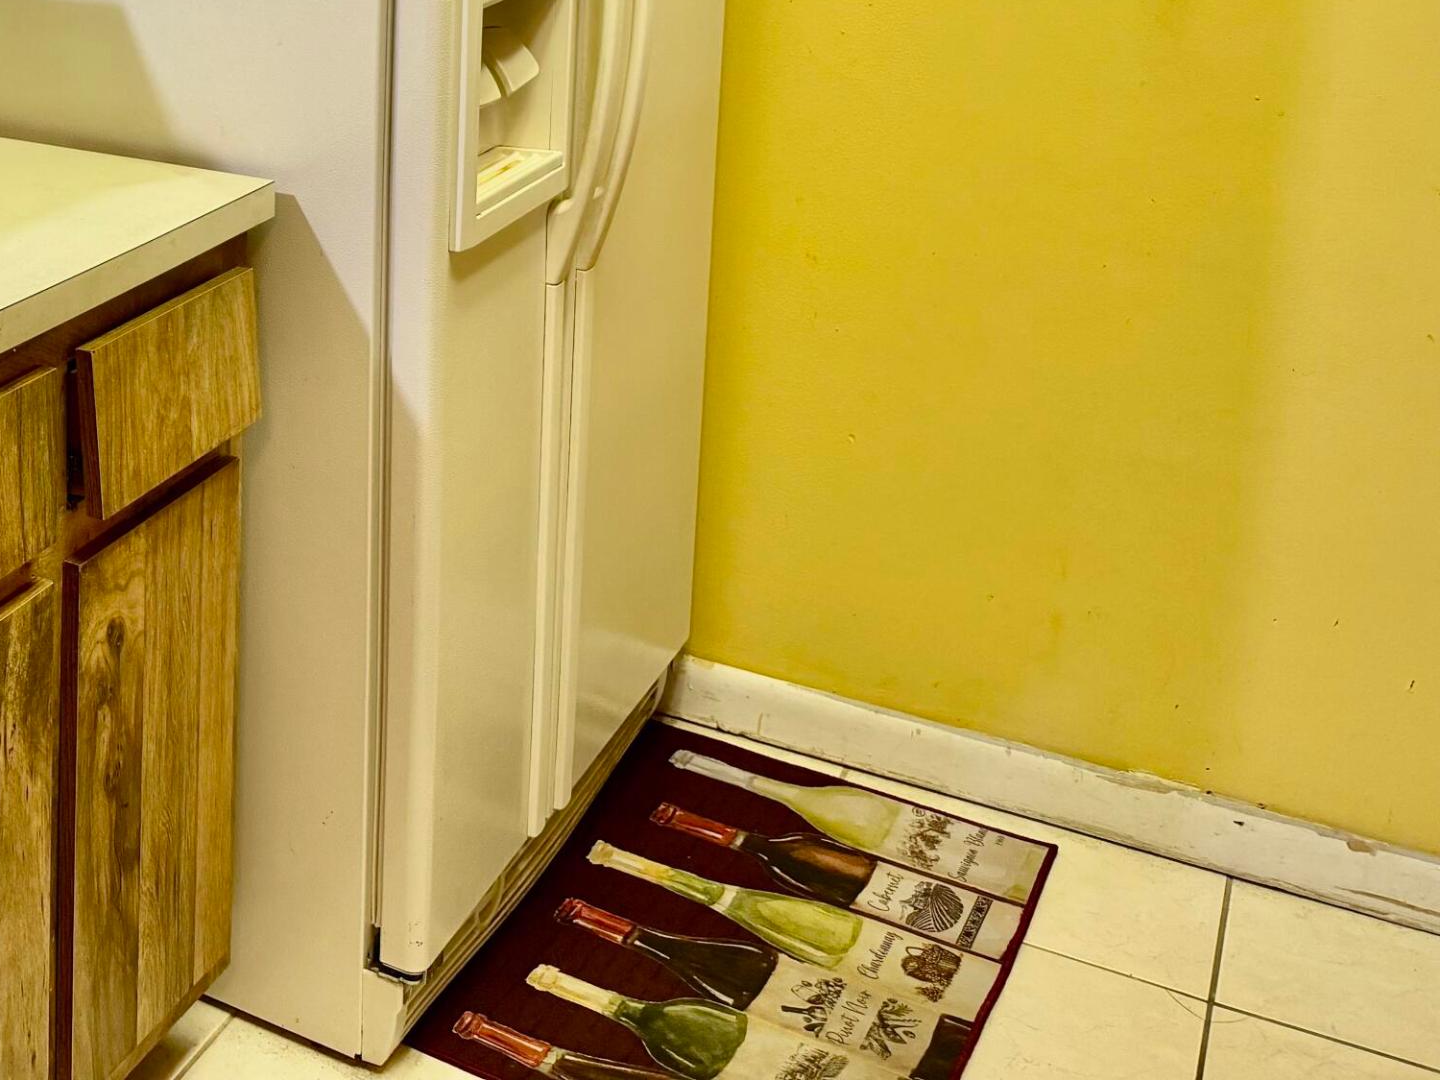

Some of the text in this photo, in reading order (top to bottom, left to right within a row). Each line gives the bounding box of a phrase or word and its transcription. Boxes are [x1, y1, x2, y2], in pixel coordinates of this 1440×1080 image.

[867, 871, 905, 911] Cabernet
[857, 931, 905, 980] Chardonnay
[825, 989, 872, 1046] Pinot Noir
